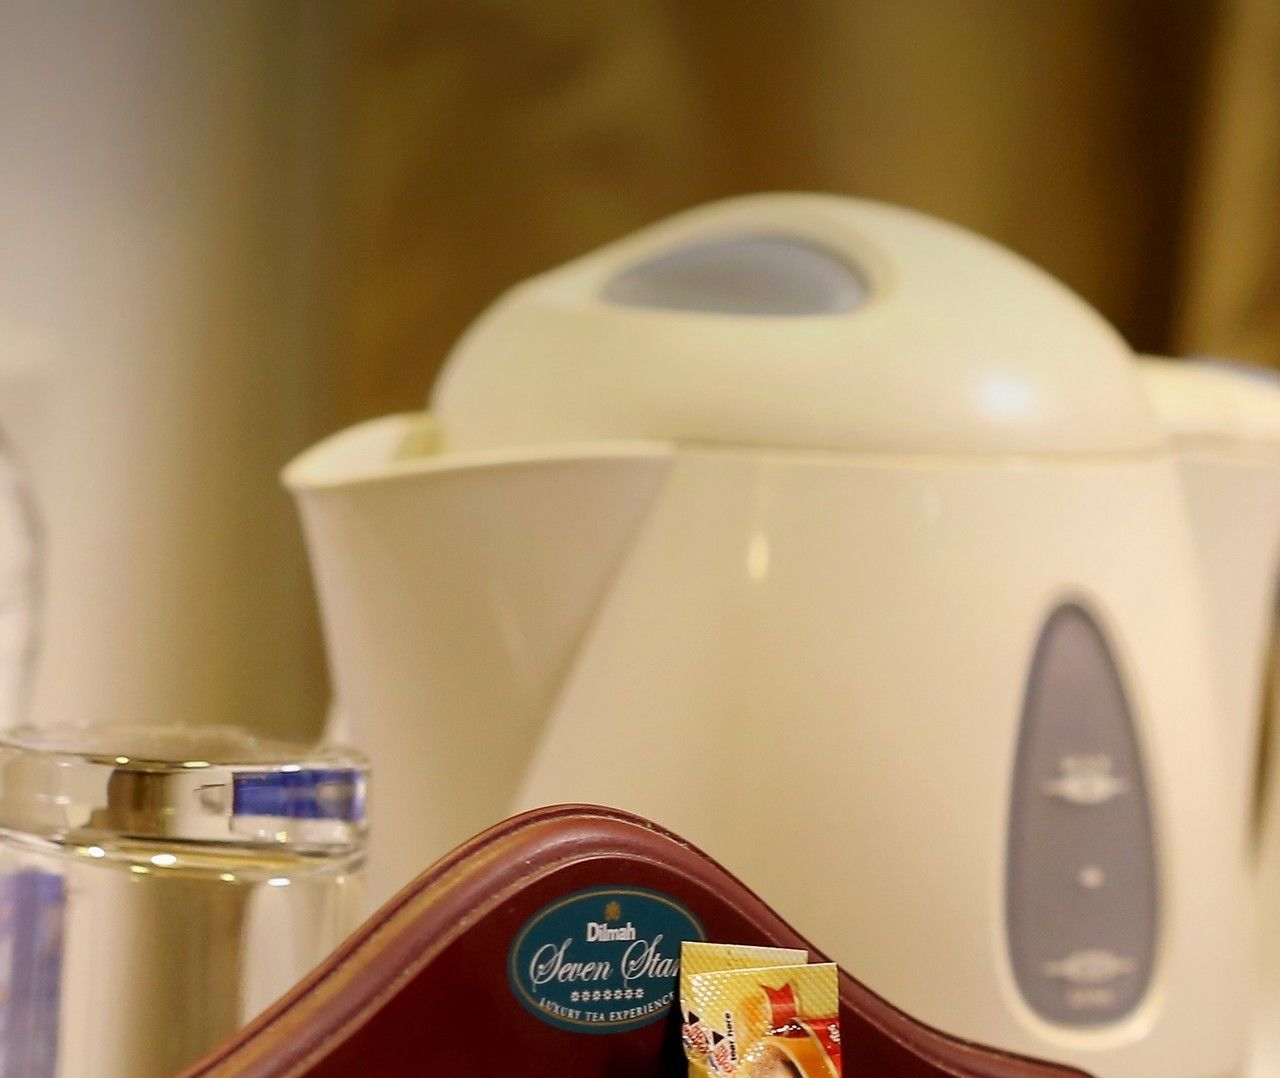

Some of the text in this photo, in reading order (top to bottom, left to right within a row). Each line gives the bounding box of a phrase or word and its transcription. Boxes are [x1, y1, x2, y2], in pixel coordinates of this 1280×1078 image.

[586, 922, 636, 942] Dilmah
[529, 938, 612, 993] Seven
[539, 997, 581, 1020] LUXURY
[585, 1011, 605, 1022] TEA
